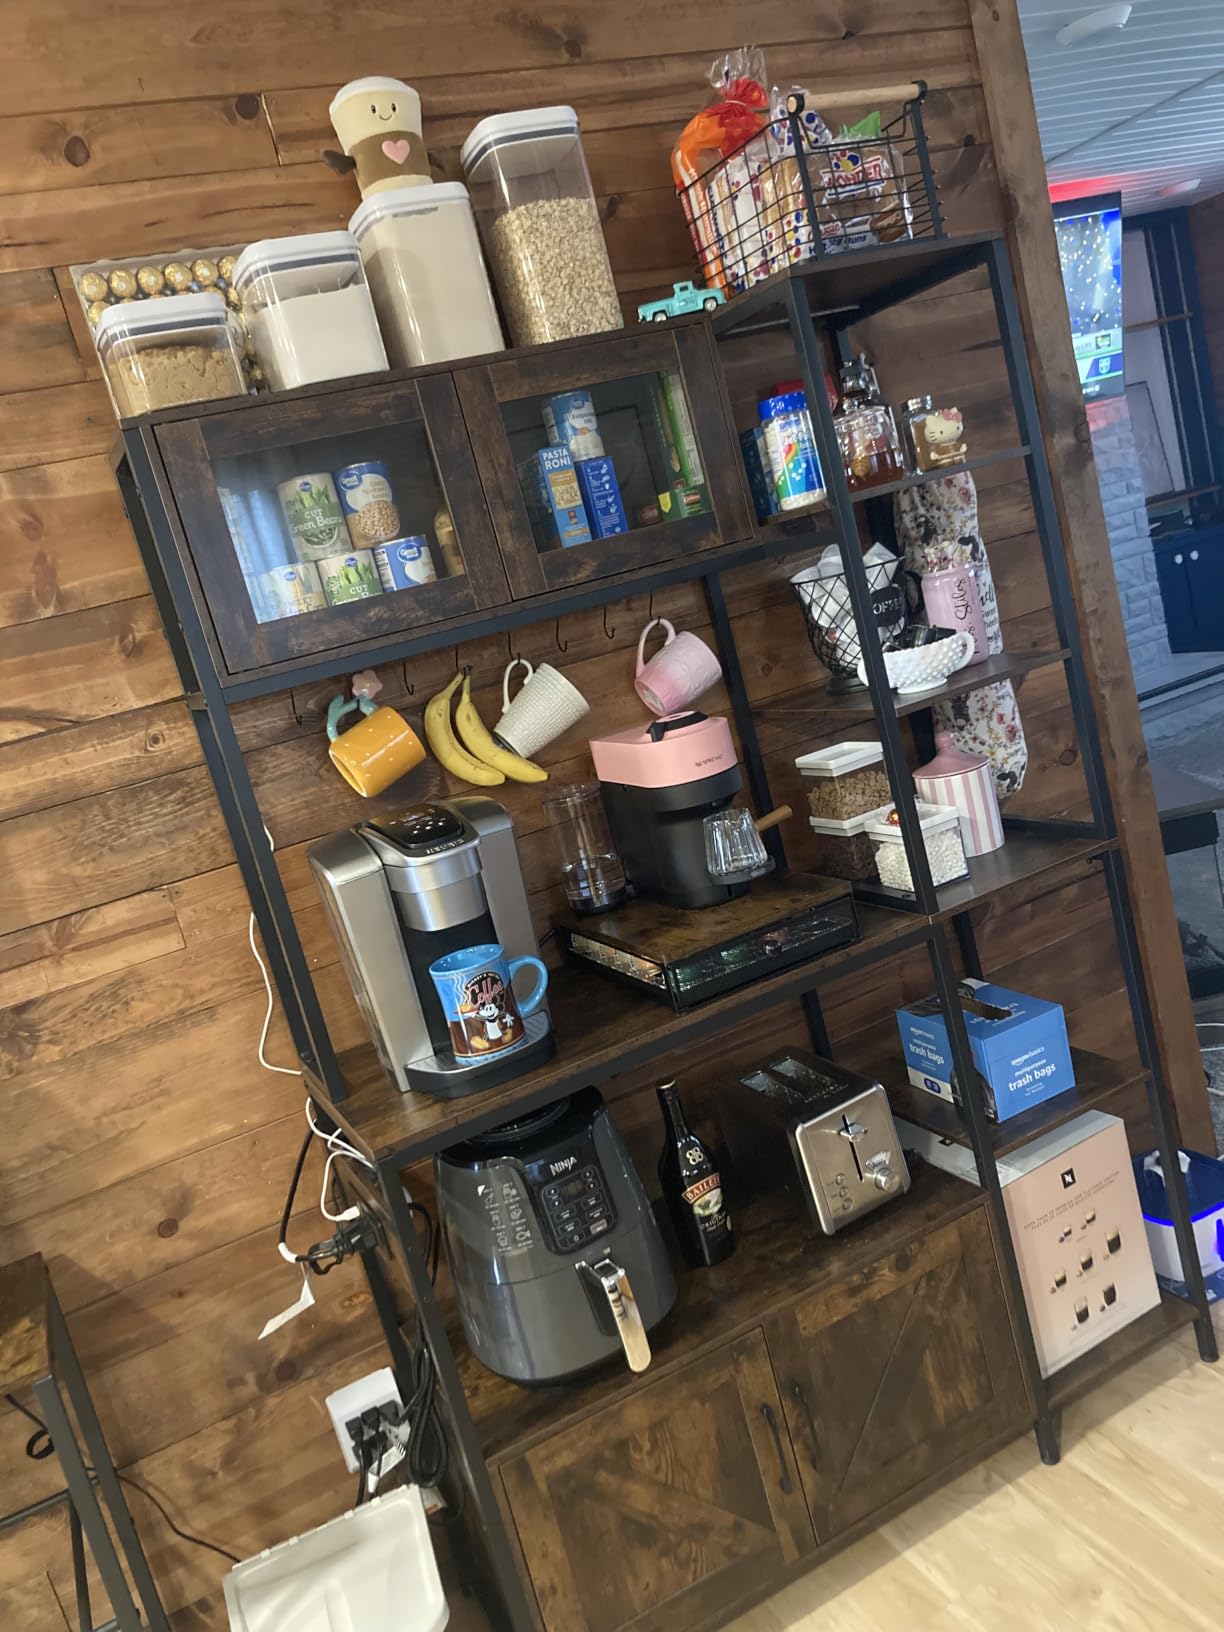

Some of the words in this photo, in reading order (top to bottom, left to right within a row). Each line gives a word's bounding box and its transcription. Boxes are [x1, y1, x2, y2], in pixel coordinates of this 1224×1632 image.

[542, 448, 569, 461] PASTA
[544, 456, 571, 470] RONI
[304, 509, 323, 519] CUT
[349, 584, 369, 595] CUT
[1008, 1073, 1033, 1092] trash
[1033, 1063, 1056, 1080] bags
[549, 1156, 577, 1177] NINJA
